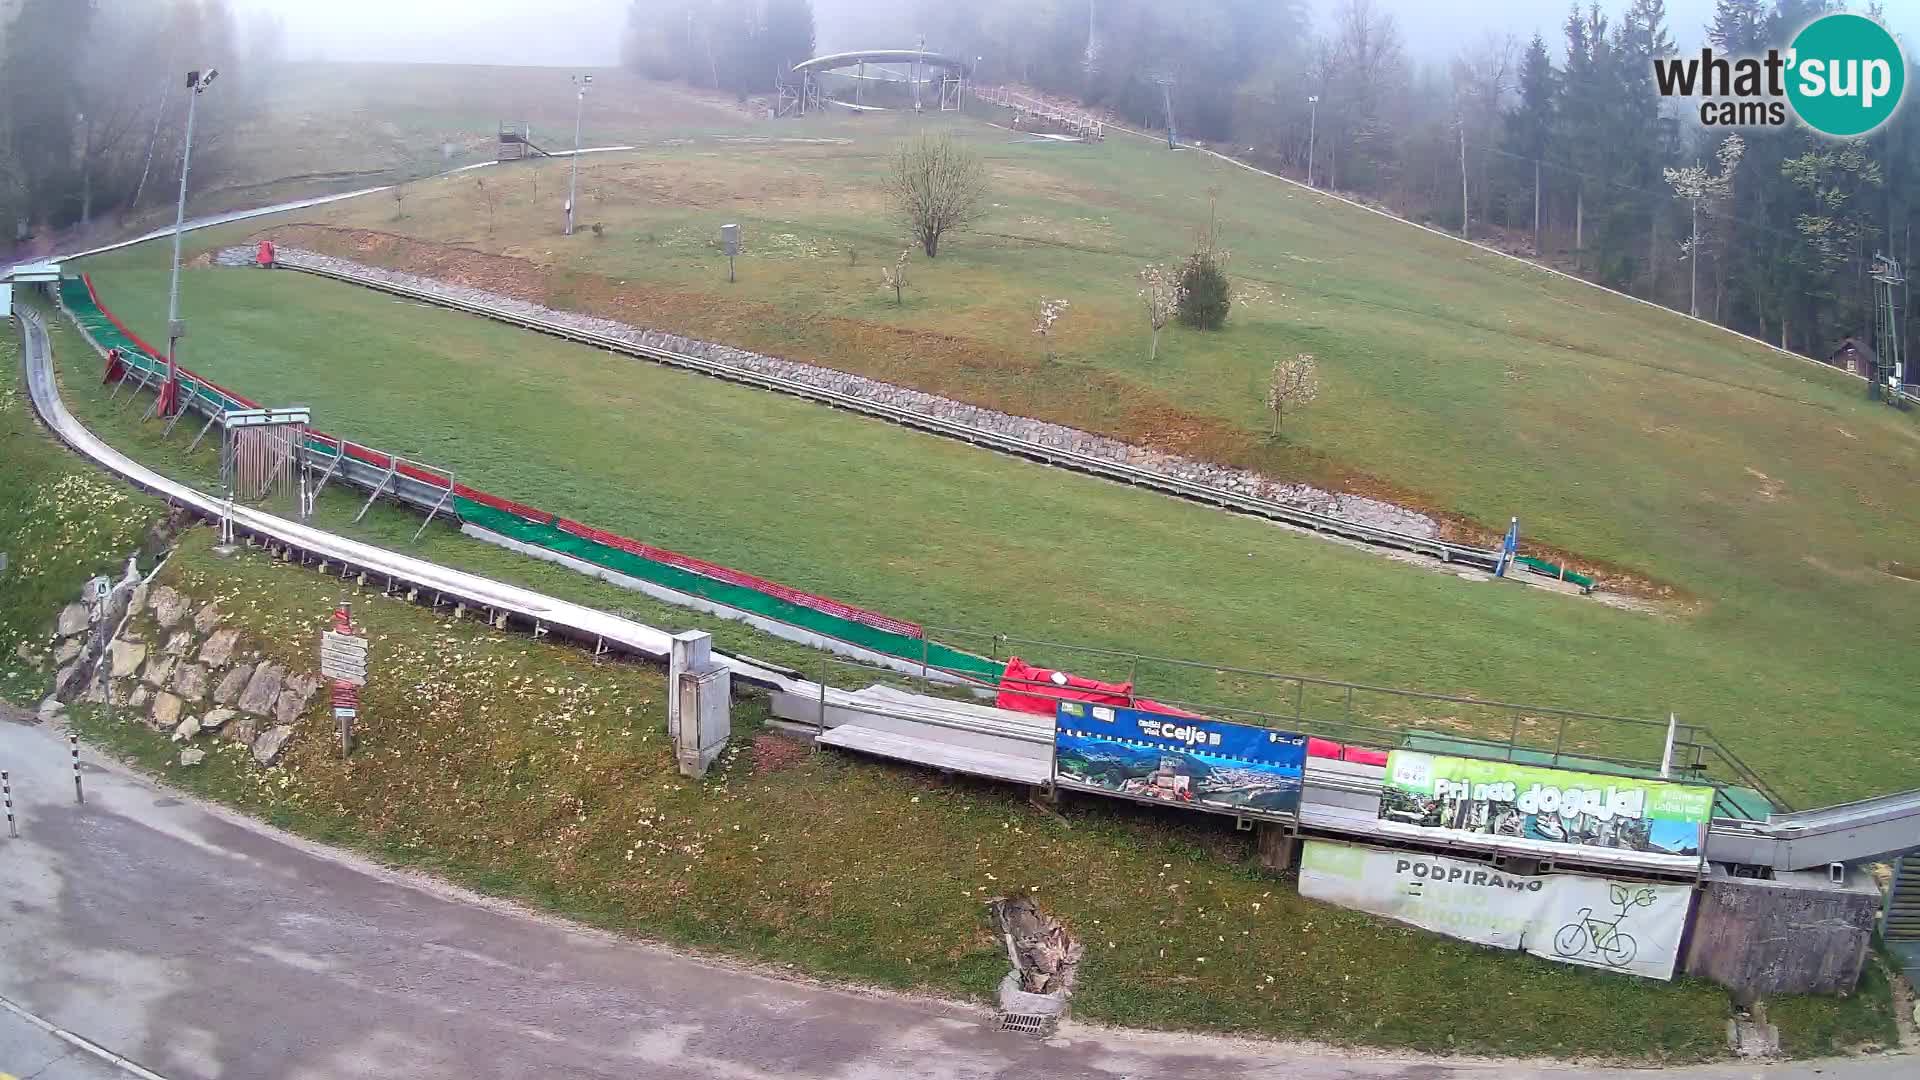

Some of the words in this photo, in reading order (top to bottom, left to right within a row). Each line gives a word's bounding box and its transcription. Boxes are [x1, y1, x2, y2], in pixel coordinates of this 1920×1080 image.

[1161, 723, 1207, 745] Celje
[1434, 778, 1470, 801] Pri
[1473, 782, 1517, 802] nas
[1396, 859, 1543, 893] PODPIRAMO
